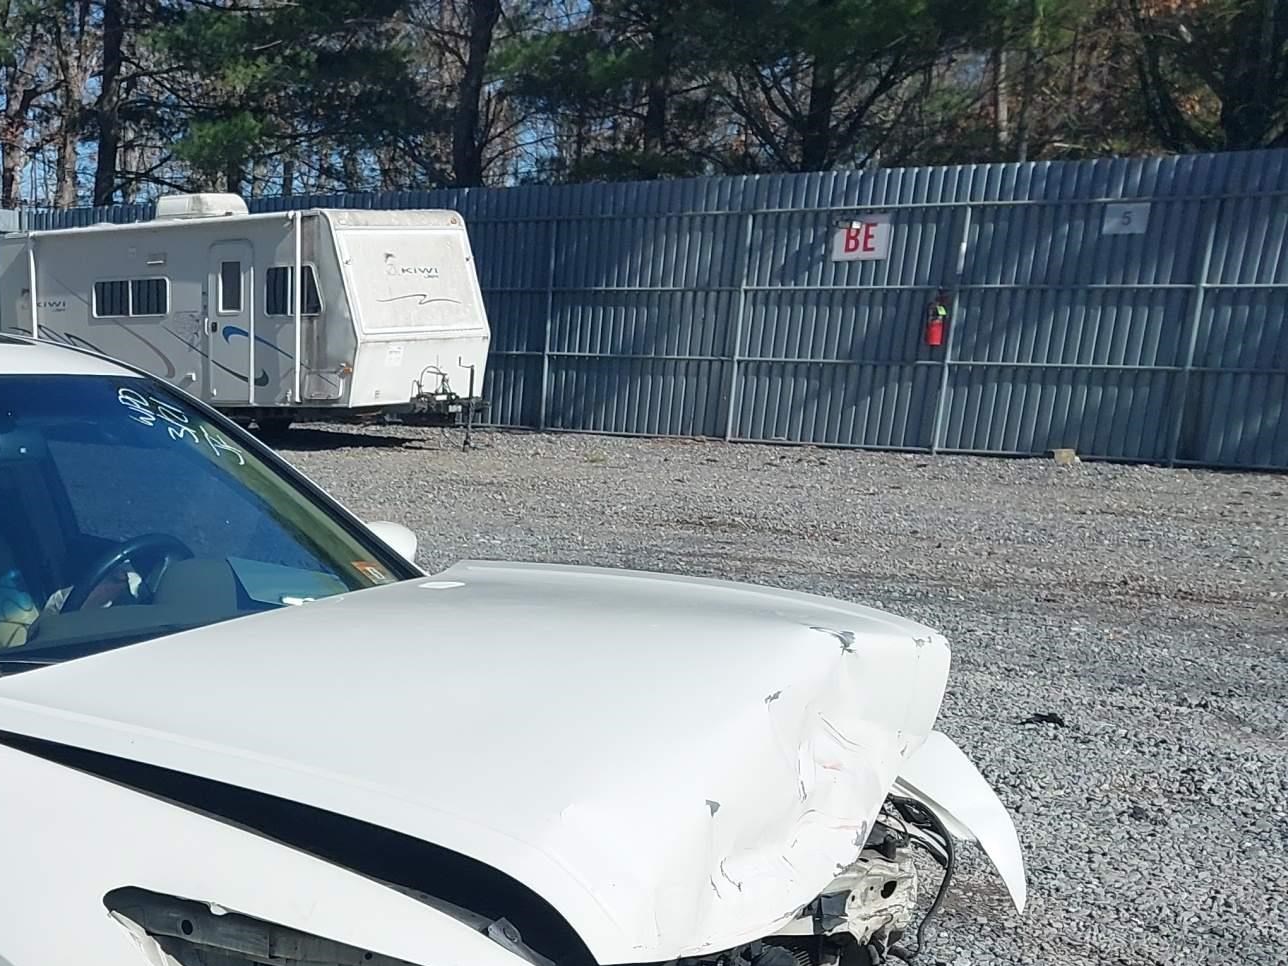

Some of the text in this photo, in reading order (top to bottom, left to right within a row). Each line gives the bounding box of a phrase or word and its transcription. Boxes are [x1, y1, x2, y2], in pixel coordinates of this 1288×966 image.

[1121, 210, 1133, 226] 5
[843, 222, 879, 253] BE
[401, 266, 439, 274] KIWI
